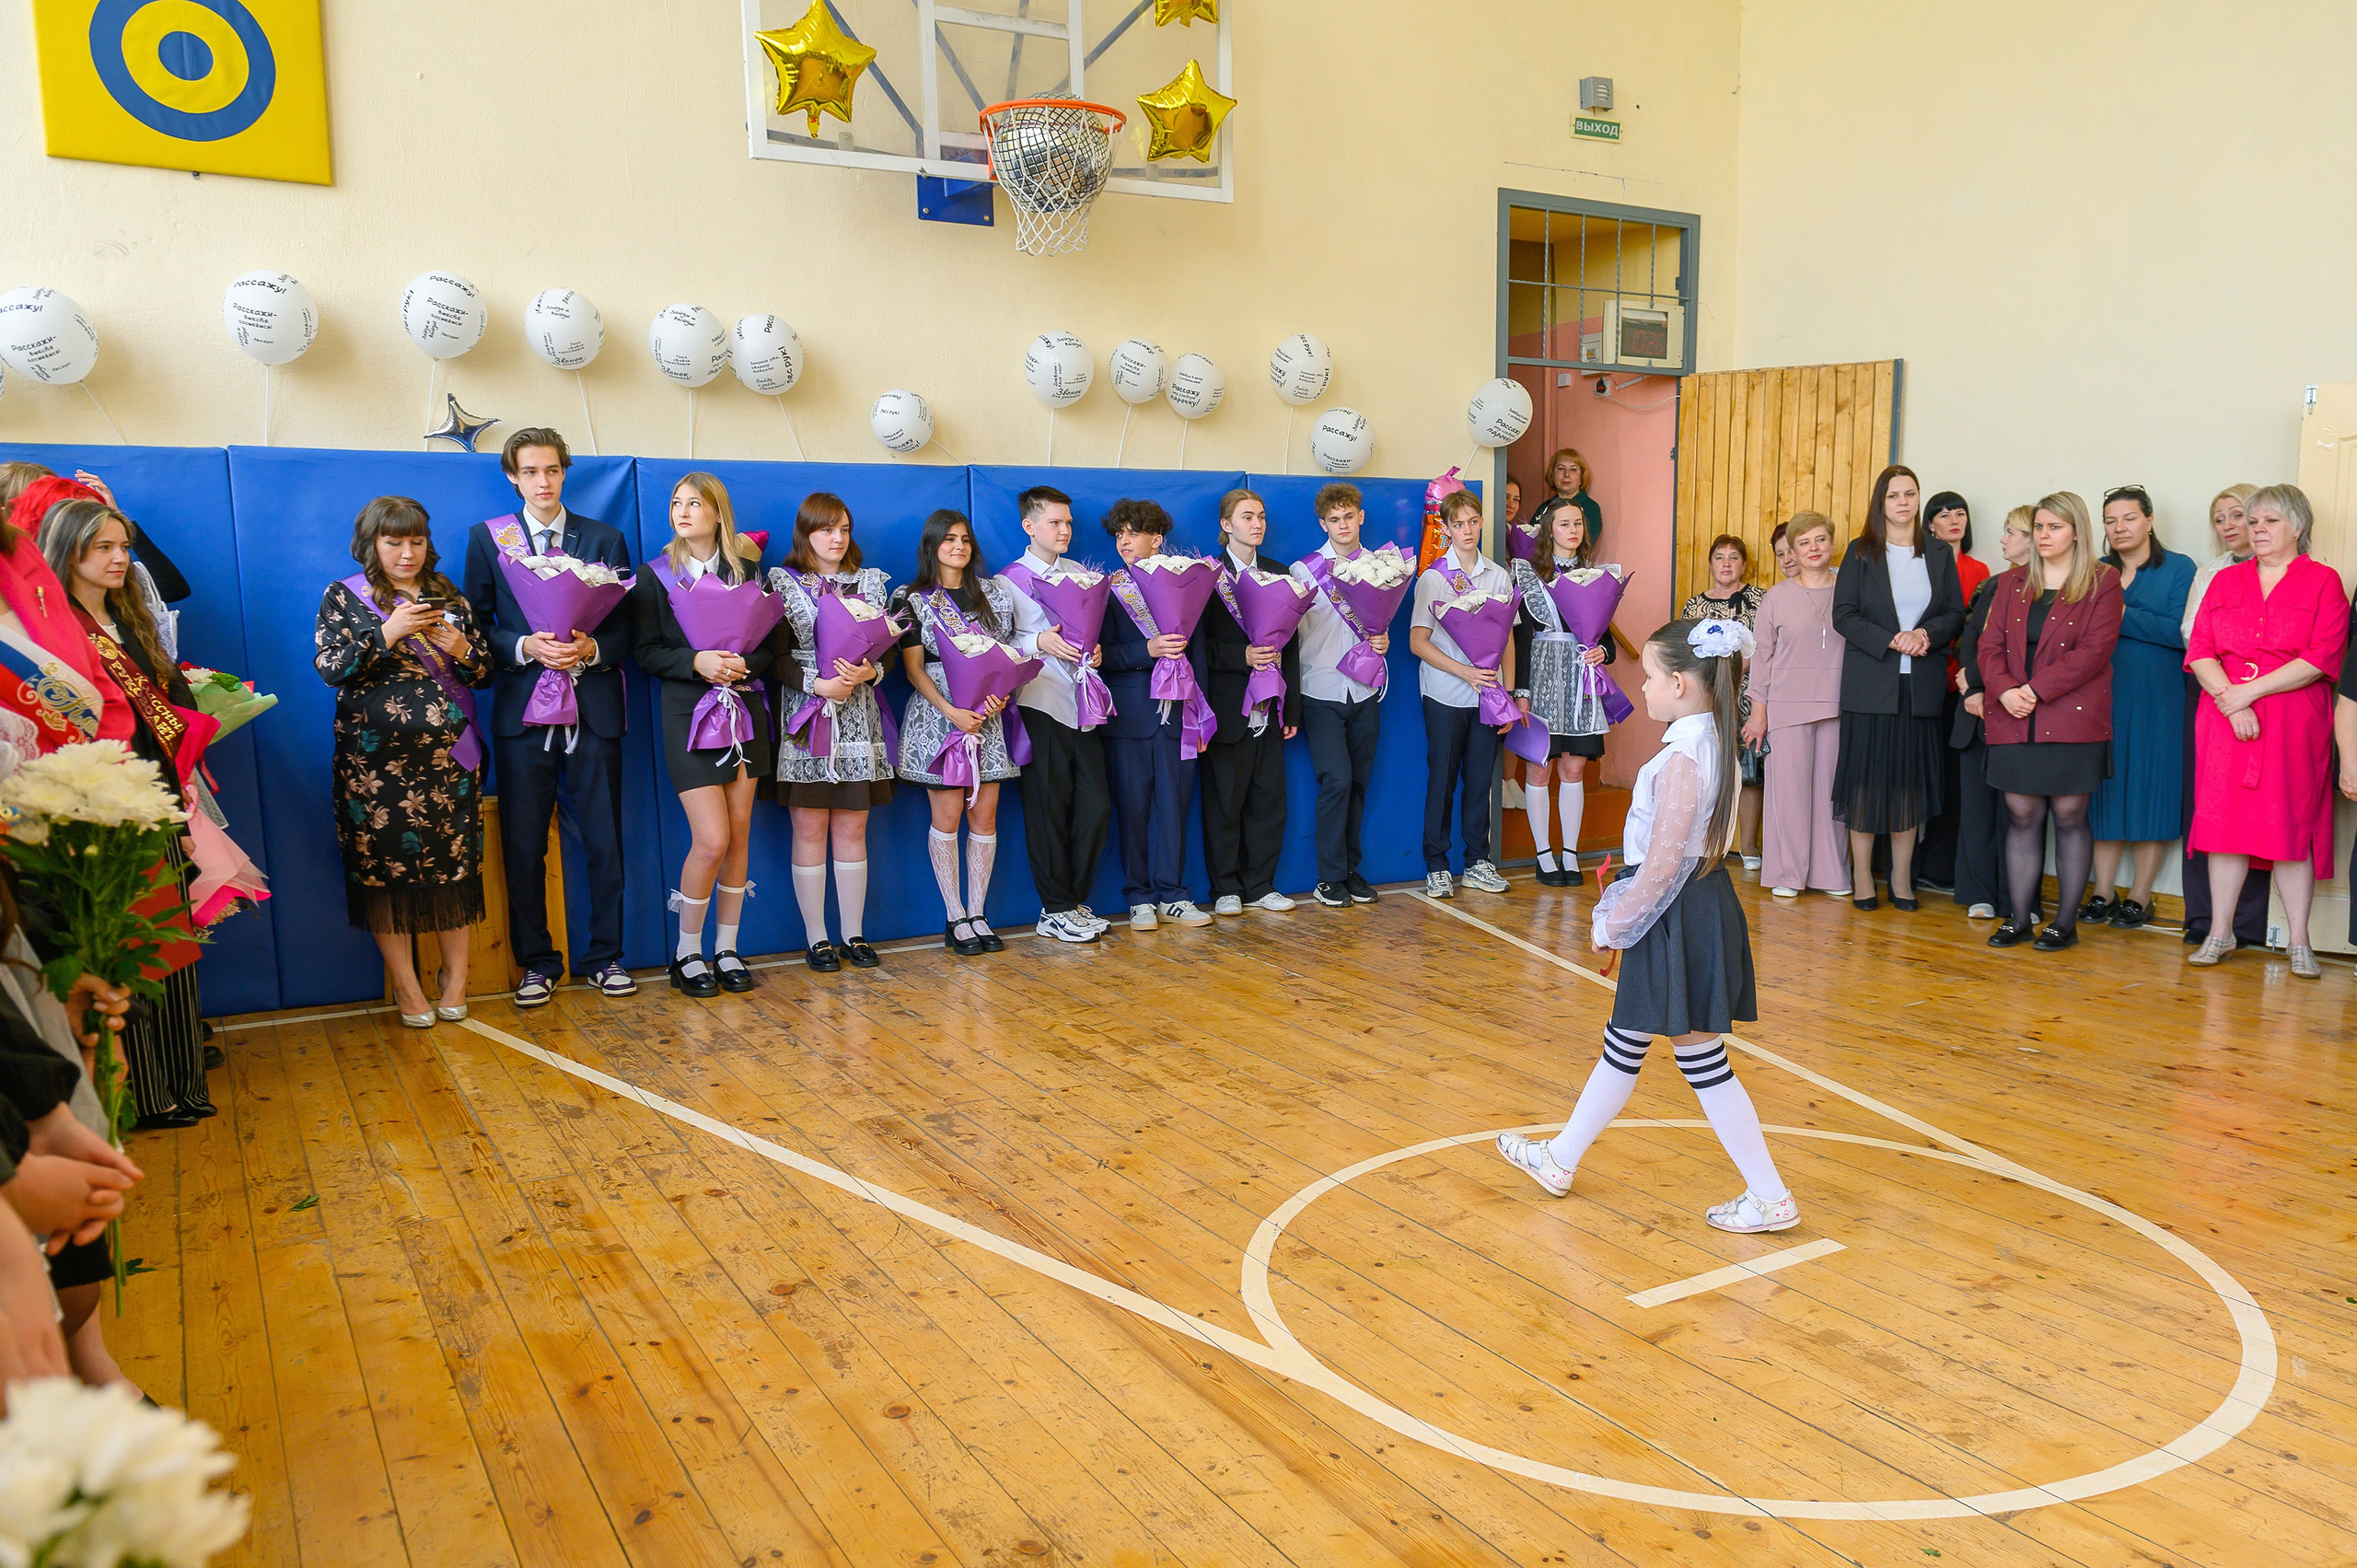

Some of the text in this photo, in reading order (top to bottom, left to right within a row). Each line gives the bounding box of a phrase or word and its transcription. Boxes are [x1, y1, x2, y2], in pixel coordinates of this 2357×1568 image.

[1575, 121, 1619, 137] ВЫХОД
[429, 275, 475, 298] Рассажу!
[0, 304, 43, 313] ассажу!
[778, 345, 793, 368] рук!
[1056, 388, 1082, 396] Звонок
[1172, 383, 1201, 397] Рассажу
[1170, 394, 1201, 408] парочку!
[1322, 424, 1358, 442] Рассажу!
